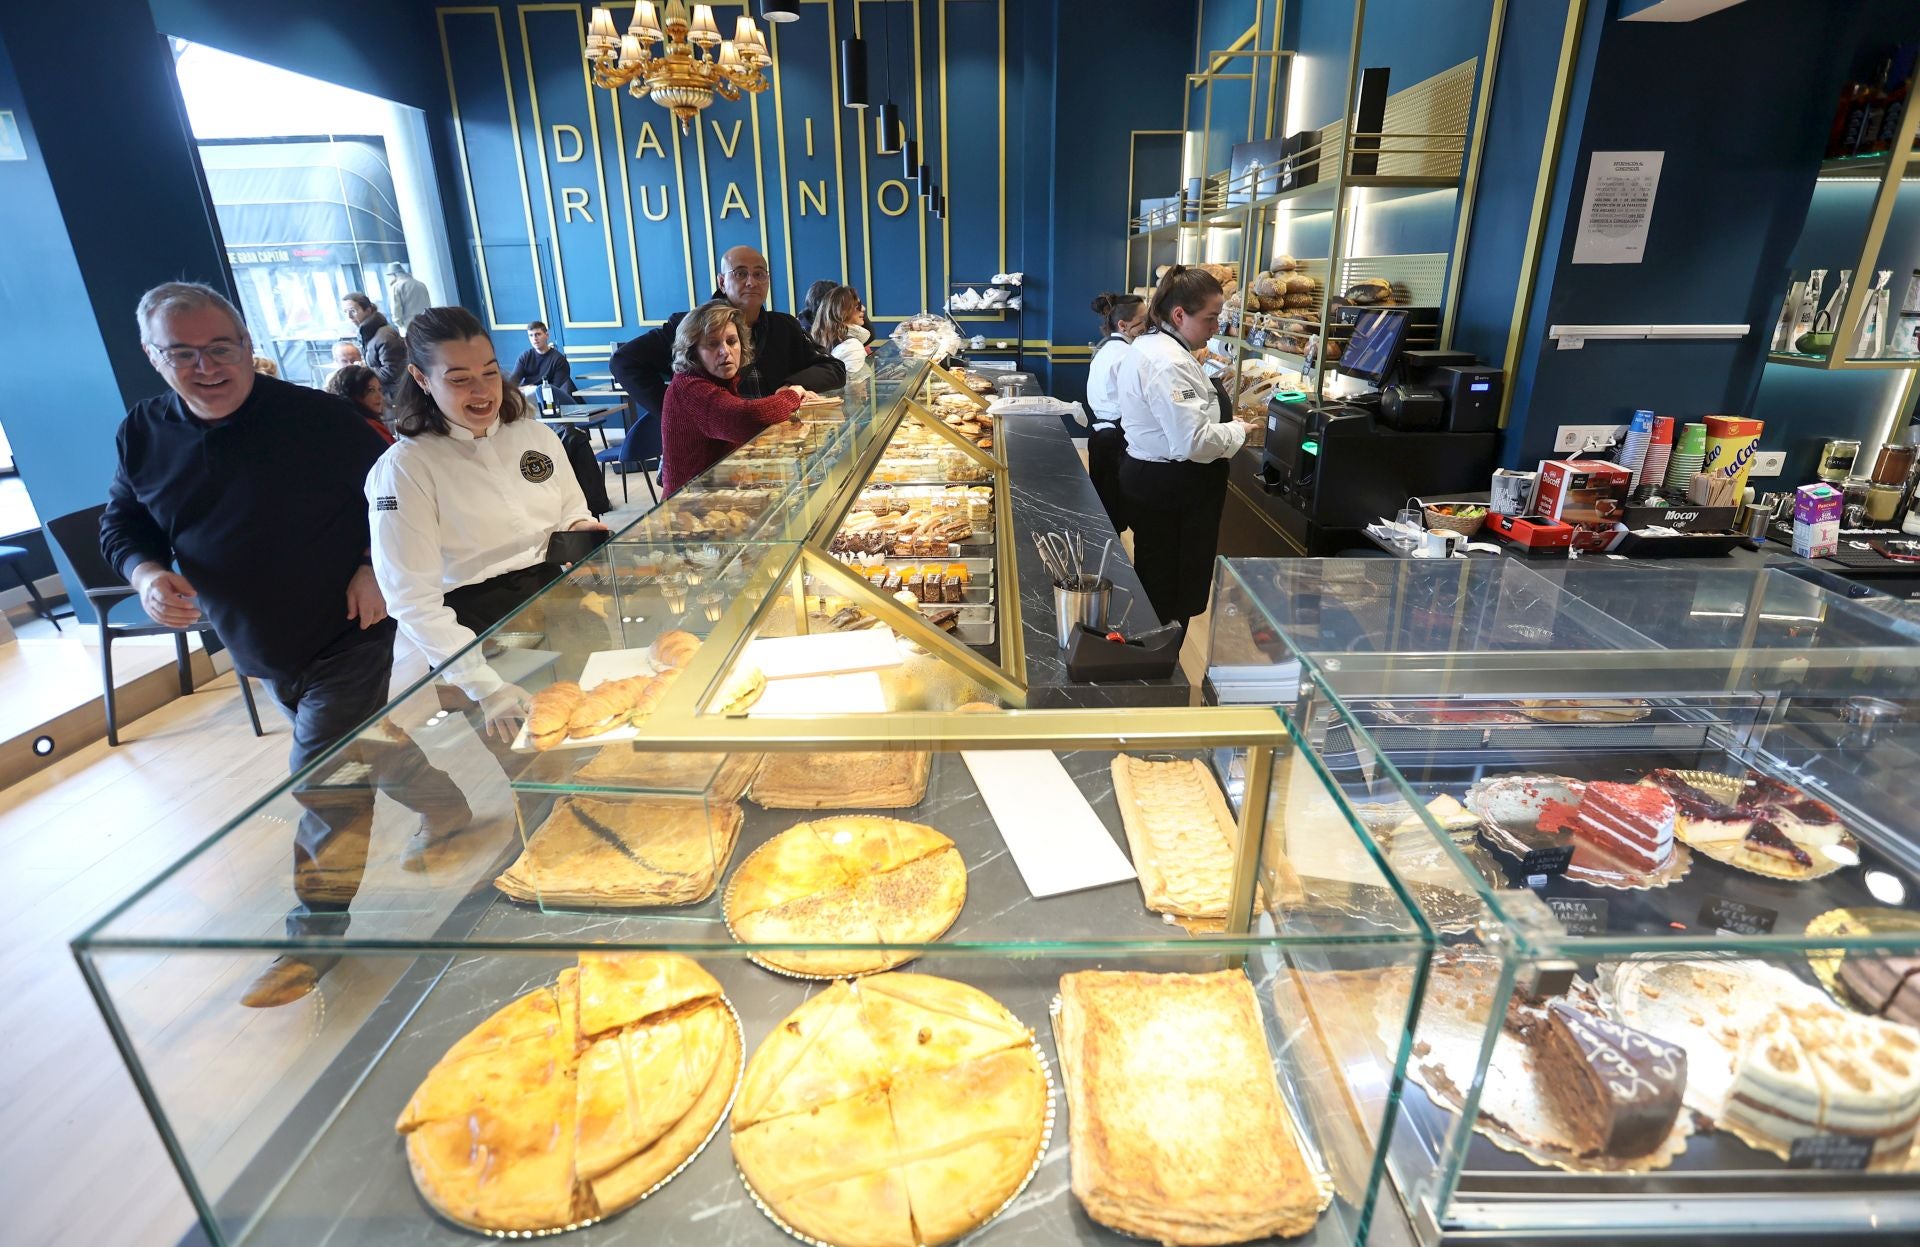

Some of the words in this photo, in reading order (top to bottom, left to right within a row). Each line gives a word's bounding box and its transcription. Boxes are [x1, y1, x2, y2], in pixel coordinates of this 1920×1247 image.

[561, 179, 910, 223] RUANO
[1725, 438, 1760, 477] laCao
[1542, 472, 1562, 488] Biscoff
[1664, 510, 1699, 521] Mocay
[1552, 901, 1588, 911] TARTA
[1712, 906, 1769, 925] VELVET
[1567, 1018, 1660, 1099] Sacher
[1583, 1012, 1683, 1081] Sacher
